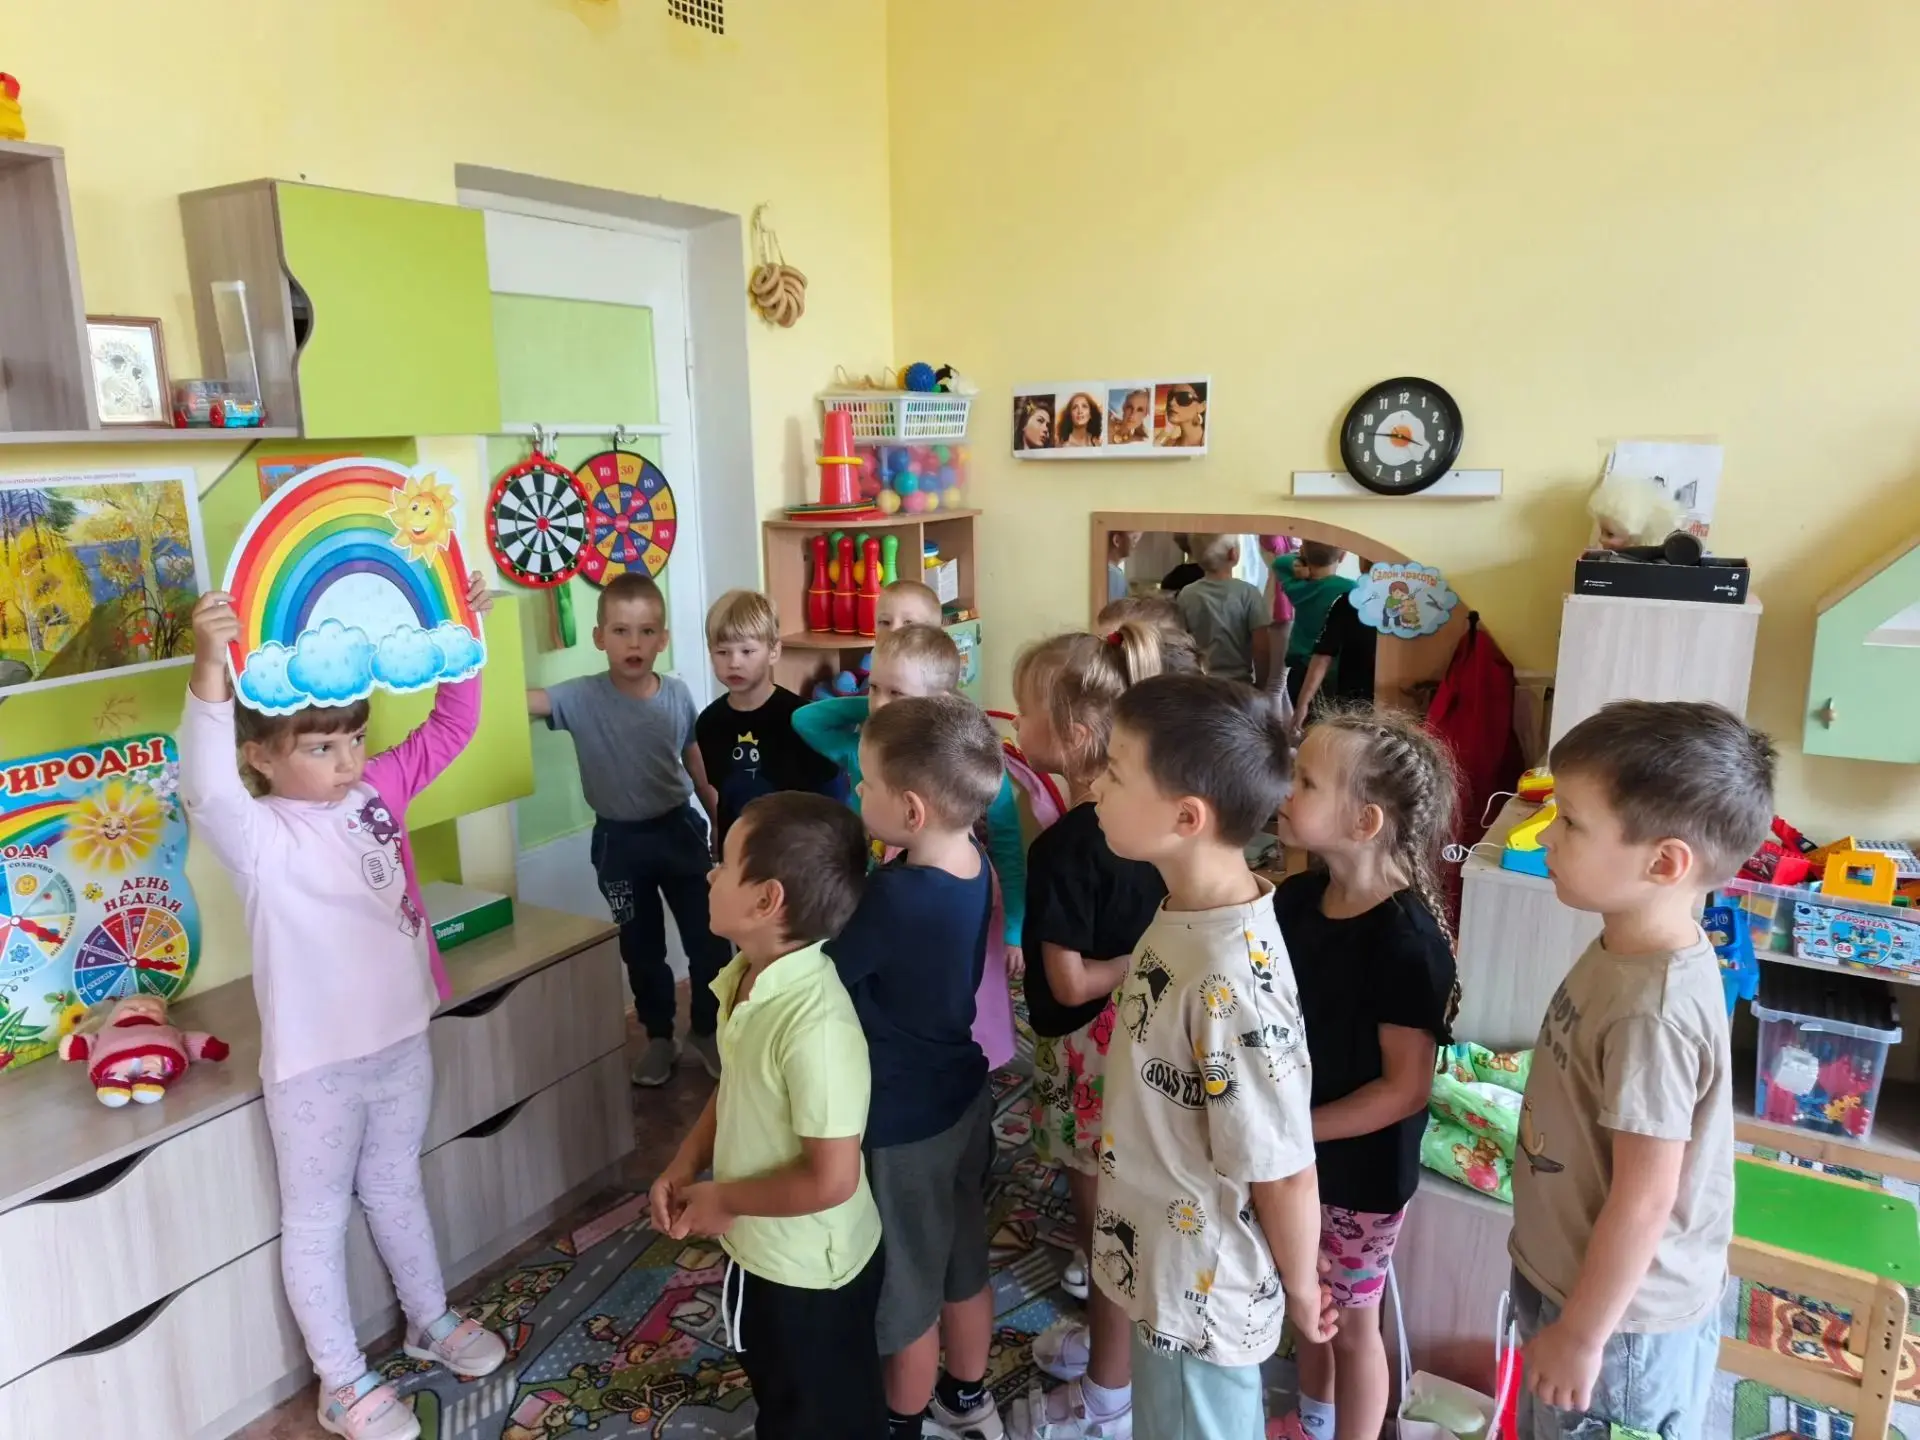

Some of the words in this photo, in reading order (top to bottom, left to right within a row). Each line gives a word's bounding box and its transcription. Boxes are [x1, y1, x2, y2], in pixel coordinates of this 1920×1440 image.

[1380, 398, 1388, 410] 11
[1399, 392, 1410, 404] 12
[1421, 396, 1427, 408] 1
[1363, 414, 1374, 426] 10
[1432, 411, 1439, 423] 2
[1358, 432, 1364, 444] 9
[1437, 429, 1445, 442] 3
[1363, 451, 1370, 462] 8
[1429, 449, 1436, 461] 4
[600, 467, 610, 477] 10
[1375, 465, 1382, 477] 7
[1394, 470, 1401, 482] 6
[1415, 464, 1422, 476] 5
[644, 479, 654, 488] 10
[660, 530, 669, 539] 10
[587, 561, 599, 570] 10
[0, 844, 49, 859] ОДА
[120, 876, 170, 893] ДЕНЬ
[103, 891, 183, 914] НЕДЕЛИ
[1834, 914, 1891, 929] СТРОИТЕЛЬ
[1146, 1063, 1180, 1098] STOP
